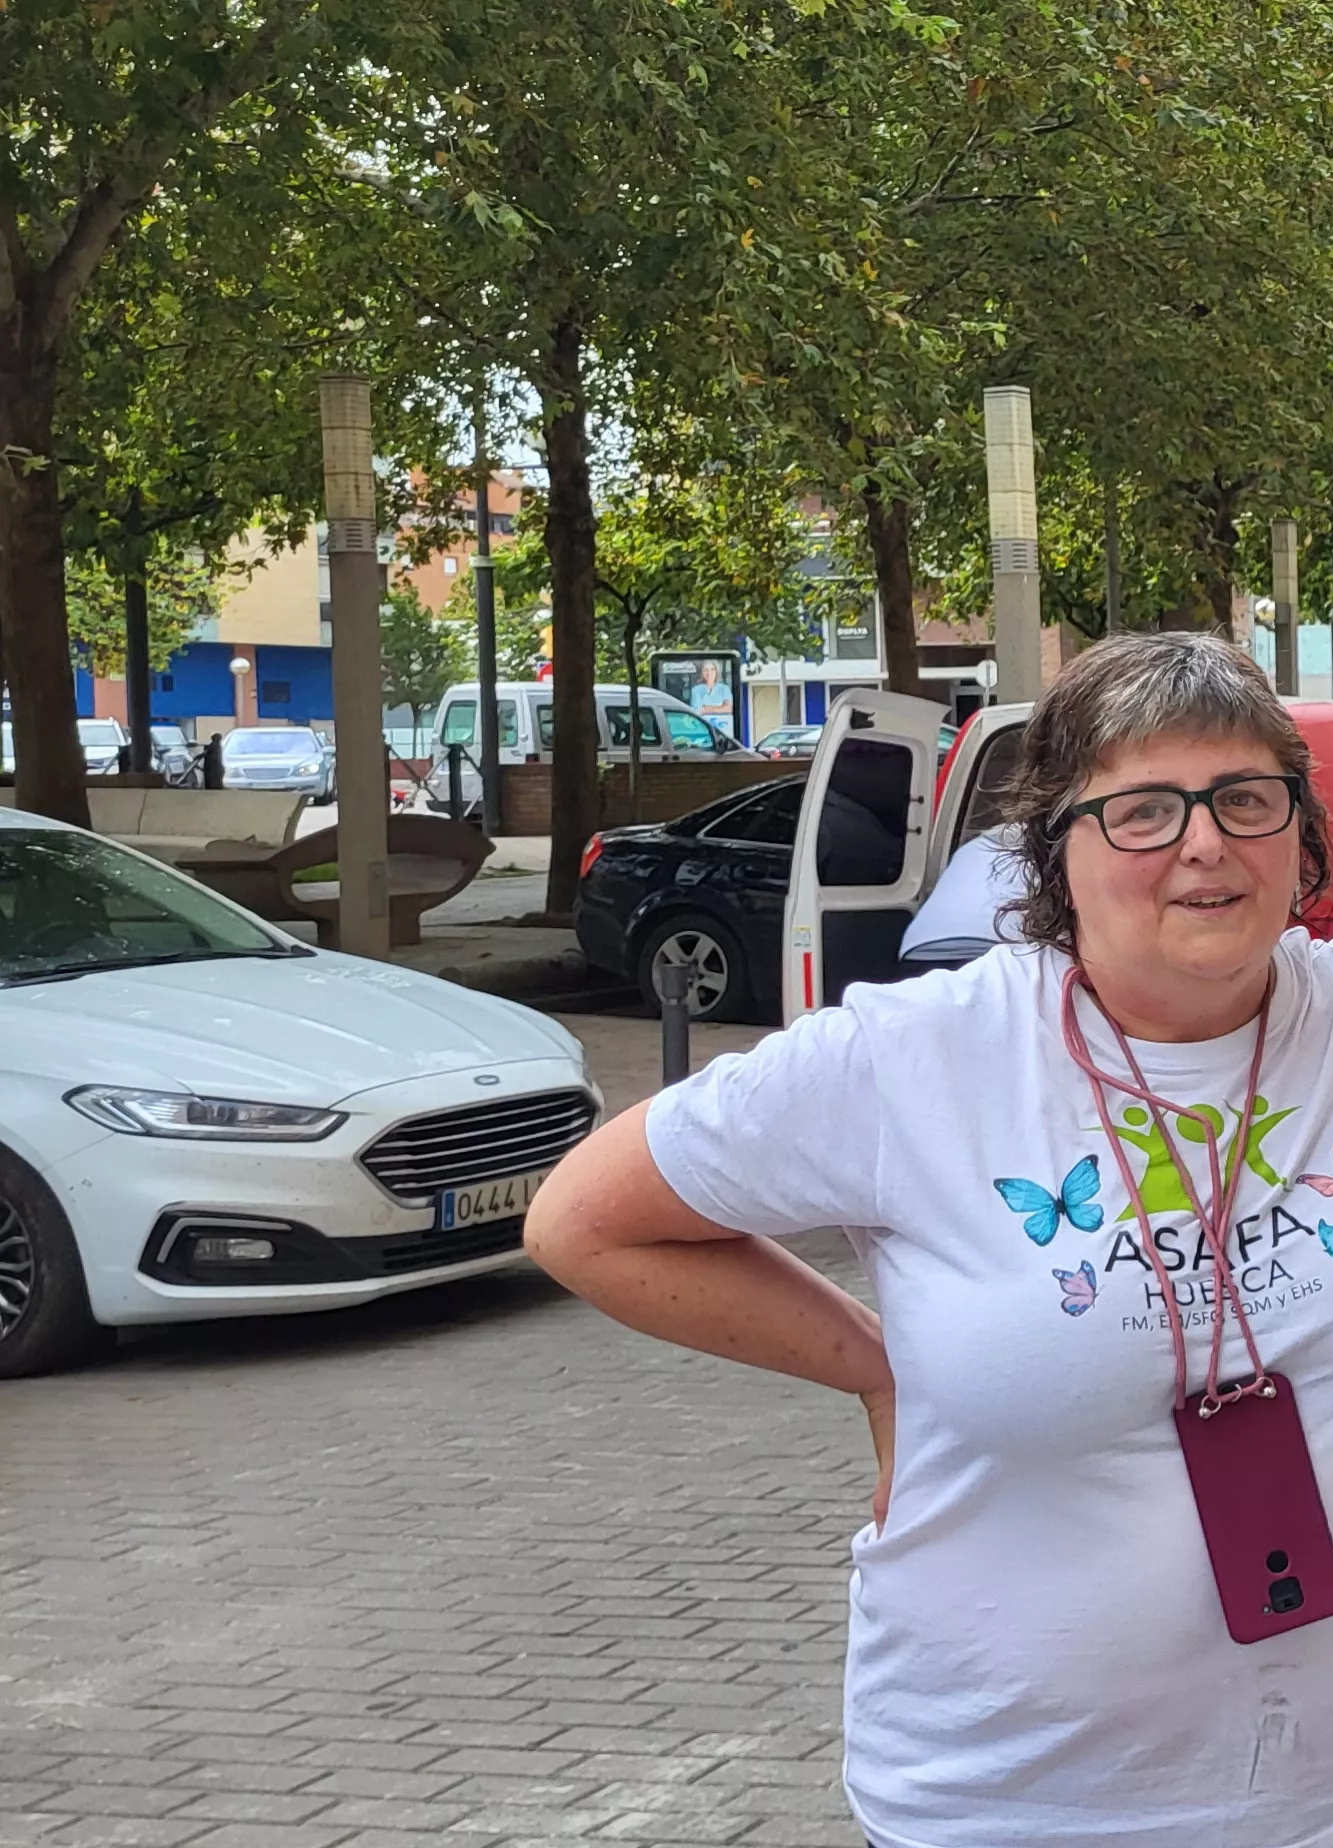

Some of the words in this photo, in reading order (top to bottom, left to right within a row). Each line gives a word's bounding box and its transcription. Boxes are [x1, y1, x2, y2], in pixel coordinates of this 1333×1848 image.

[458, 1182, 515, 1220] 0444
[1105, 1205, 1316, 1272] ASAFA
[1122, 1316, 1154, 1331] FM,
[1275, 1294, 1285, 1307] y
[1292, 1279, 1322, 1300] EHS
